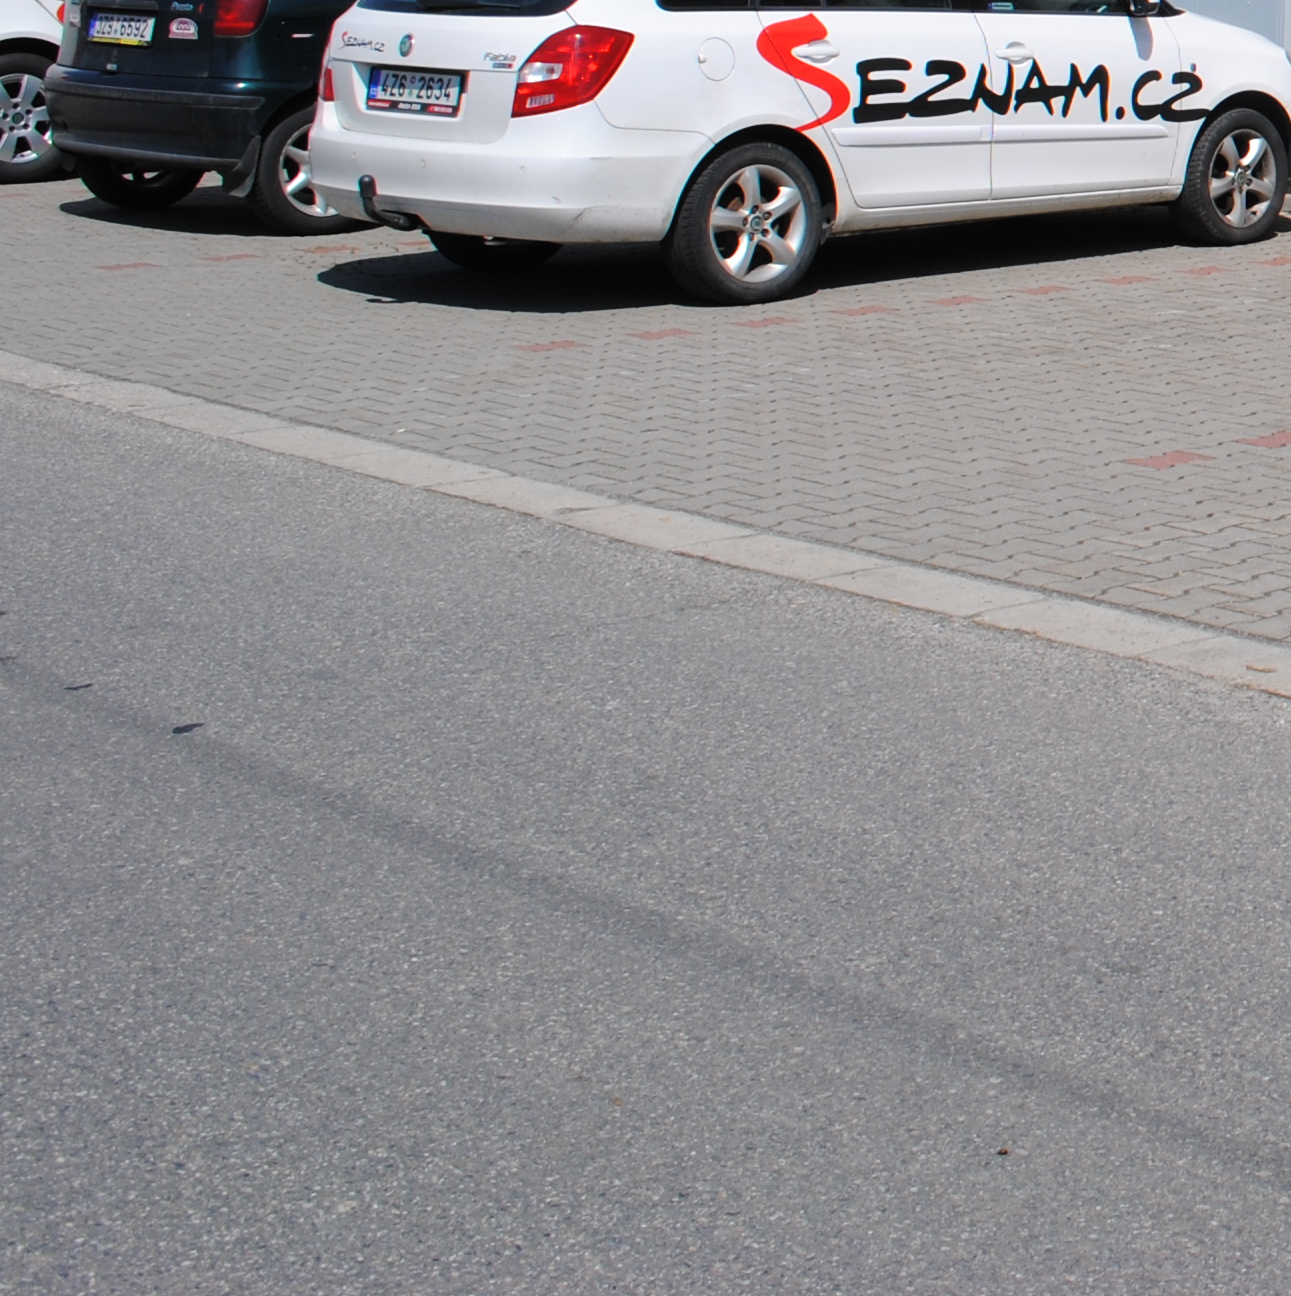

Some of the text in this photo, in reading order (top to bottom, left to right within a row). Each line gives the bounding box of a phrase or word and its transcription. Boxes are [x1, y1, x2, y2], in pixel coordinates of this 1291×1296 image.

[120, 17, 148, 38] 6592
[382, 73, 452, 101] 4Z6 2634
